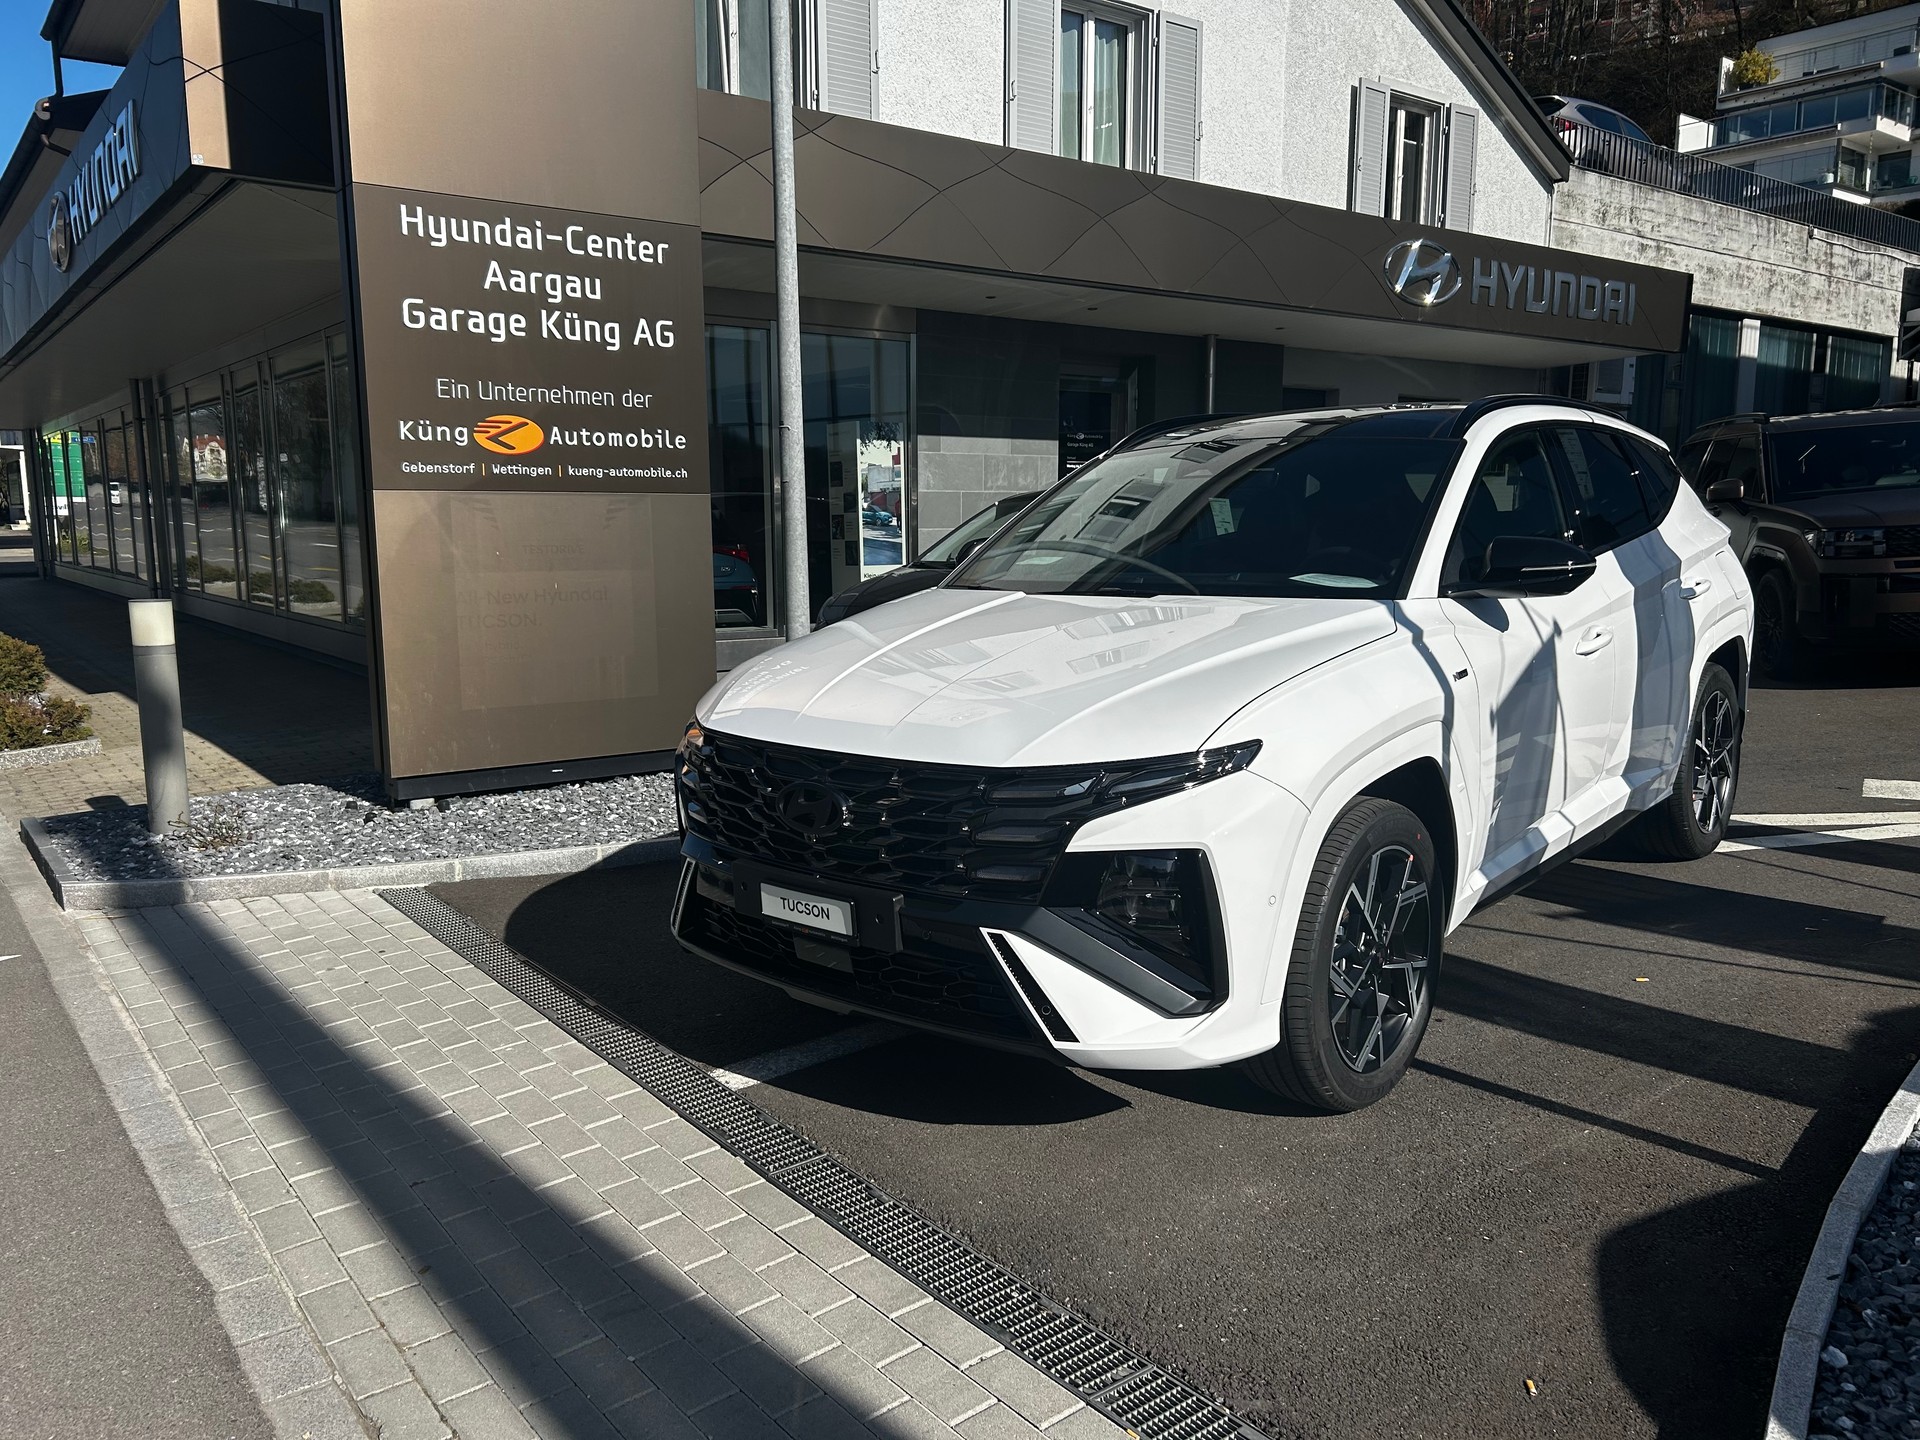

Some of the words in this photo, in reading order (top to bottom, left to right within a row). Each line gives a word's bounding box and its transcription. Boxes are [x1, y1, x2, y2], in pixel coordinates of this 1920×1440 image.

[68, 99, 141, 245] HYUNDAI
[399, 203, 669, 265] Hyundai-Center
[483, 260, 602, 304] Aargau
[1470, 256, 1636, 326] HYUNDAI
[402, 298, 527, 343] Garage
[540, 309, 621, 352] Küng
[633, 318, 675, 349] AG
[436, 378, 470, 400] Ein
[478, 380, 615, 407] Unternehmen
[622, 389, 653, 409] der
[399, 420, 469, 447] Küng
[549, 426, 688, 451] Automobile
[401, 461, 476, 475] Gebenstorf
[492, 464, 552, 477] Wettingen
[568, 464, 688, 479] kueng-automobile.ch
[534, 585, 609, 605] Hyundai
[779, 896, 831, 921] TUCSON
